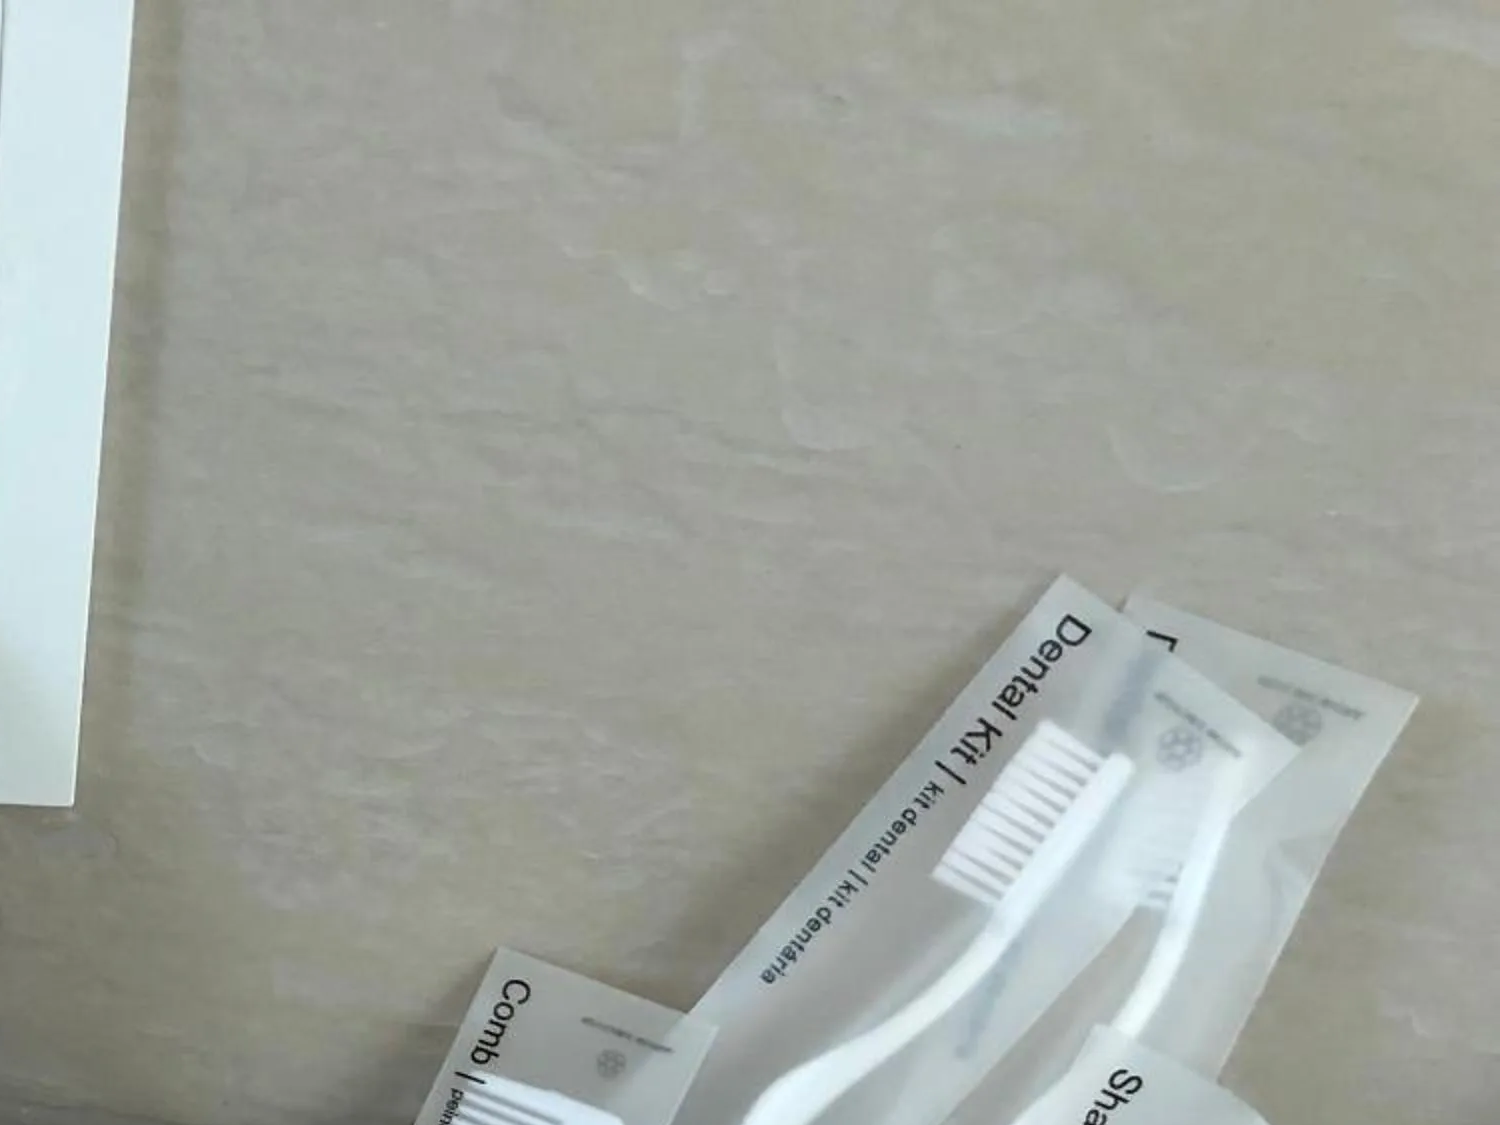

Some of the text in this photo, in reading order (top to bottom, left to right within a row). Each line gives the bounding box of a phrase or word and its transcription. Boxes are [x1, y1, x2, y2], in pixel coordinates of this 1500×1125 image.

[991, 613, 1093, 721] Dental
[950, 717, 1004, 766] Kit
[913, 780, 945, 810] kit
[860, 807, 917, 873] dental
[826, 879, 860, 909] kit
[470, 979, 532, 1065] Comb
